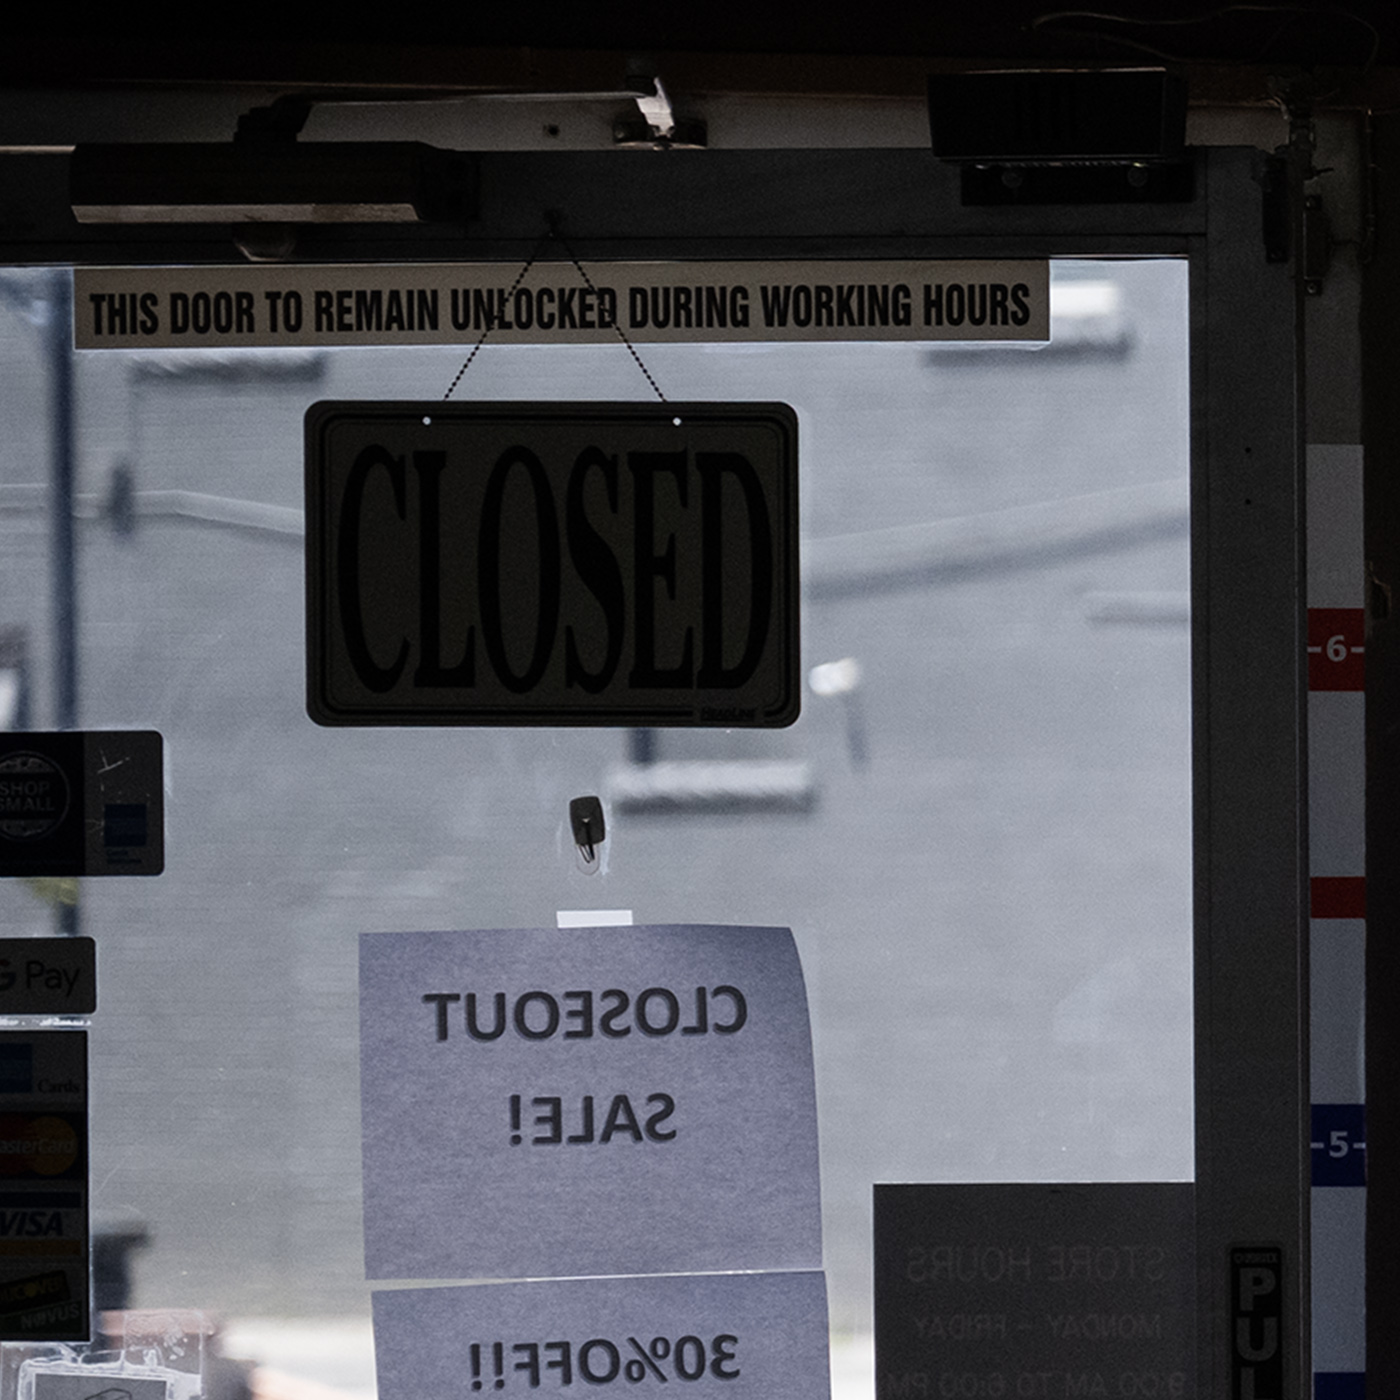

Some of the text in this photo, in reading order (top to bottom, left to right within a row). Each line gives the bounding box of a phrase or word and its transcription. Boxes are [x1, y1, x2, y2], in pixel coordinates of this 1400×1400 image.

[90, 283, 1031, 335] THIS DOOR TO REMAIN UNLOCKED DURING WORKING HOURS
[337, 444, 773, 695] CLOSED
[25, 960, 81, 998] Pay
[37, 1079, 81, 1094] Cards
[0, 1211, 64, 1237] VISA
